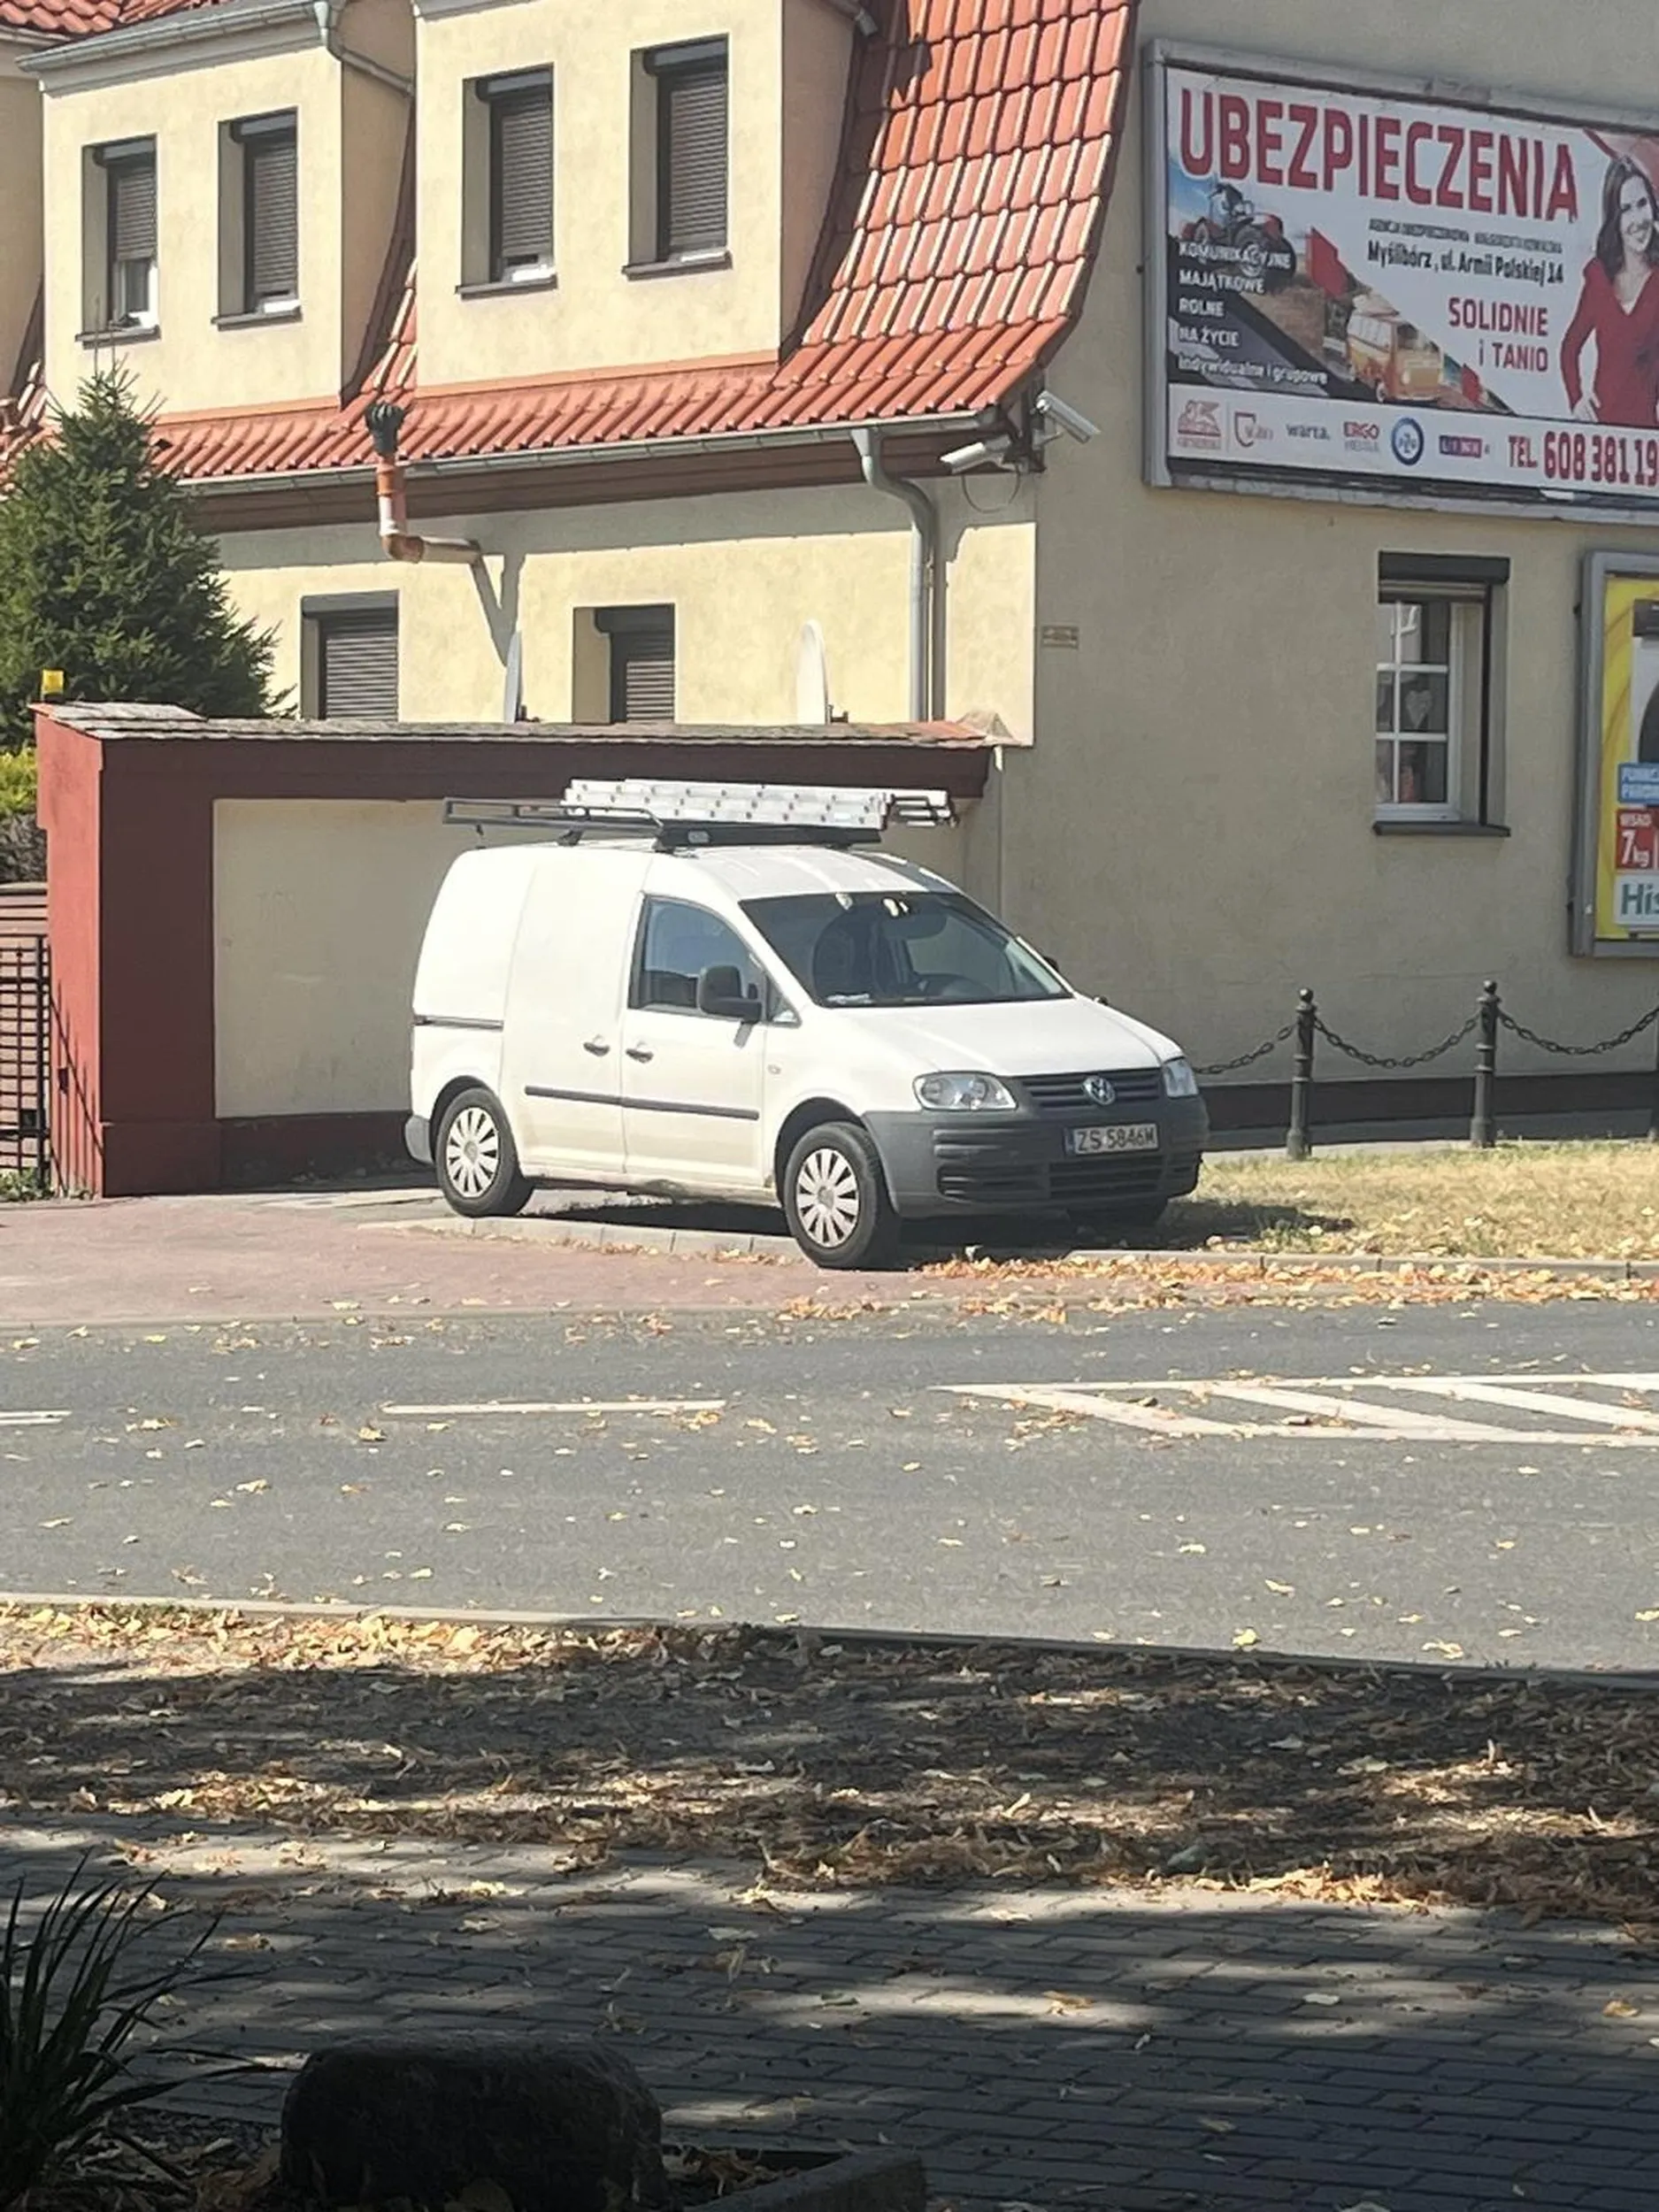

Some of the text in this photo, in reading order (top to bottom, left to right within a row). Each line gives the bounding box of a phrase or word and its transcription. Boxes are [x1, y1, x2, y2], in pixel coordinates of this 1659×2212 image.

[1179, 88, 1578, 223] UBEZPIECZENIA
[1179, 269, 1264, 295] MAJĄTKOWE
[1459, 252, 1493, 275] Armii
[1495, 255, 1546, 287] Polskiej
[1179, 297, 1225, 317] ROLNE
[1448, 296, 1548, 336] SOLIDNIE
[1179, 325, 1239, 346] NA ŻYCIE
[1492, 342, 1548, 372] TANIO
[1544, 430, 1586, 481] 608
[1592, 434, 1630, 484] 381
[1078, 1130, 1102, 1151] ZS
